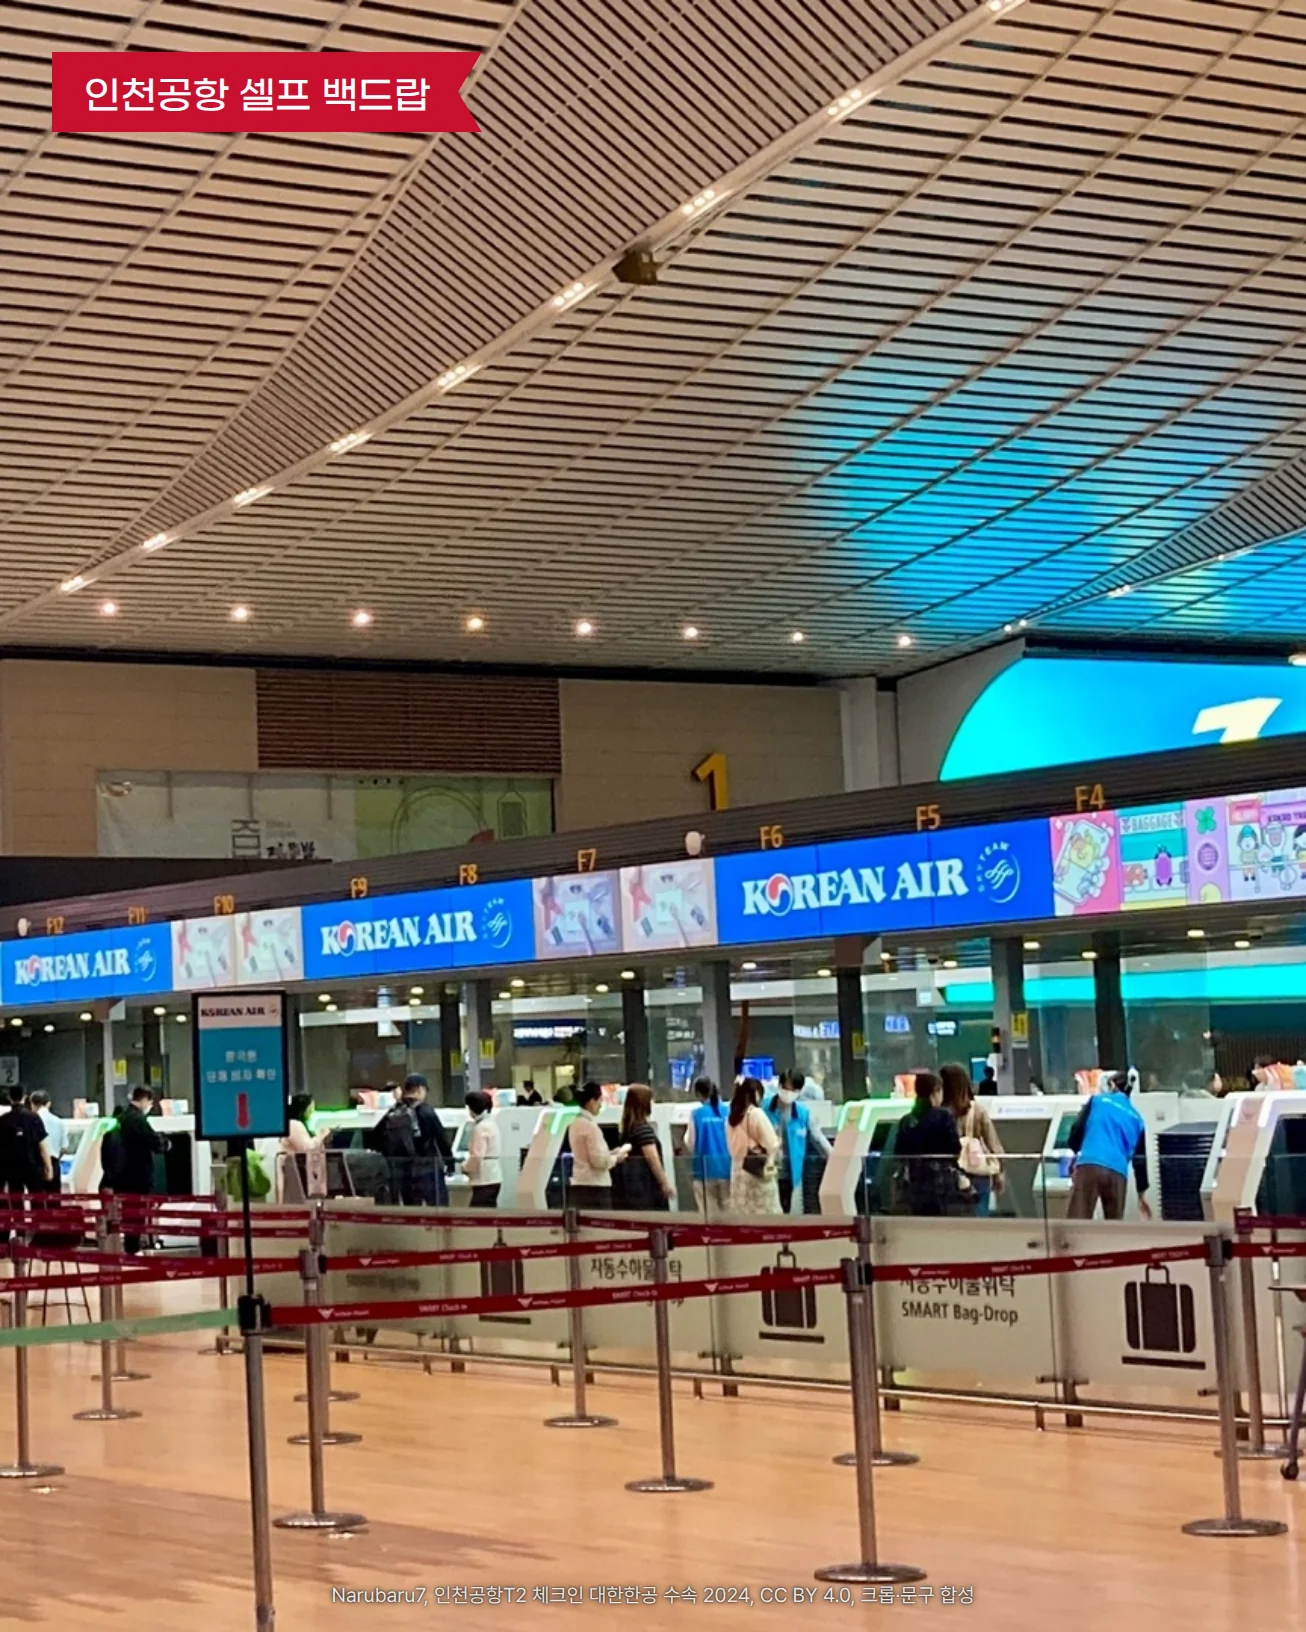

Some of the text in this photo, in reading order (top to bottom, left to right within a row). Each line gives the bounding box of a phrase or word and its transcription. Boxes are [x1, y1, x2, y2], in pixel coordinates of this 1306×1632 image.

[1074, 783, 1106, 812] F4
[915, 804, 941, 832] F5
[1131, 813, 1173, 832] BAGGAGE
[759, 824, 784, 850] F6
[577, 848, 597, 873] F7
[459, 863, 478, 885] F8
[742, 857, 969, 917] KOREAN AIR
[128, 906, 147, 925] F11
[214, 895, 235, 914] F10
[320, 910, 477, 957] KOREAN AIR
[14, 952, 90, 987] KOREAN
[91, 948, 131, 978] AIR
[901, 1301, 1019, 1327] SMART Bag-Drop
